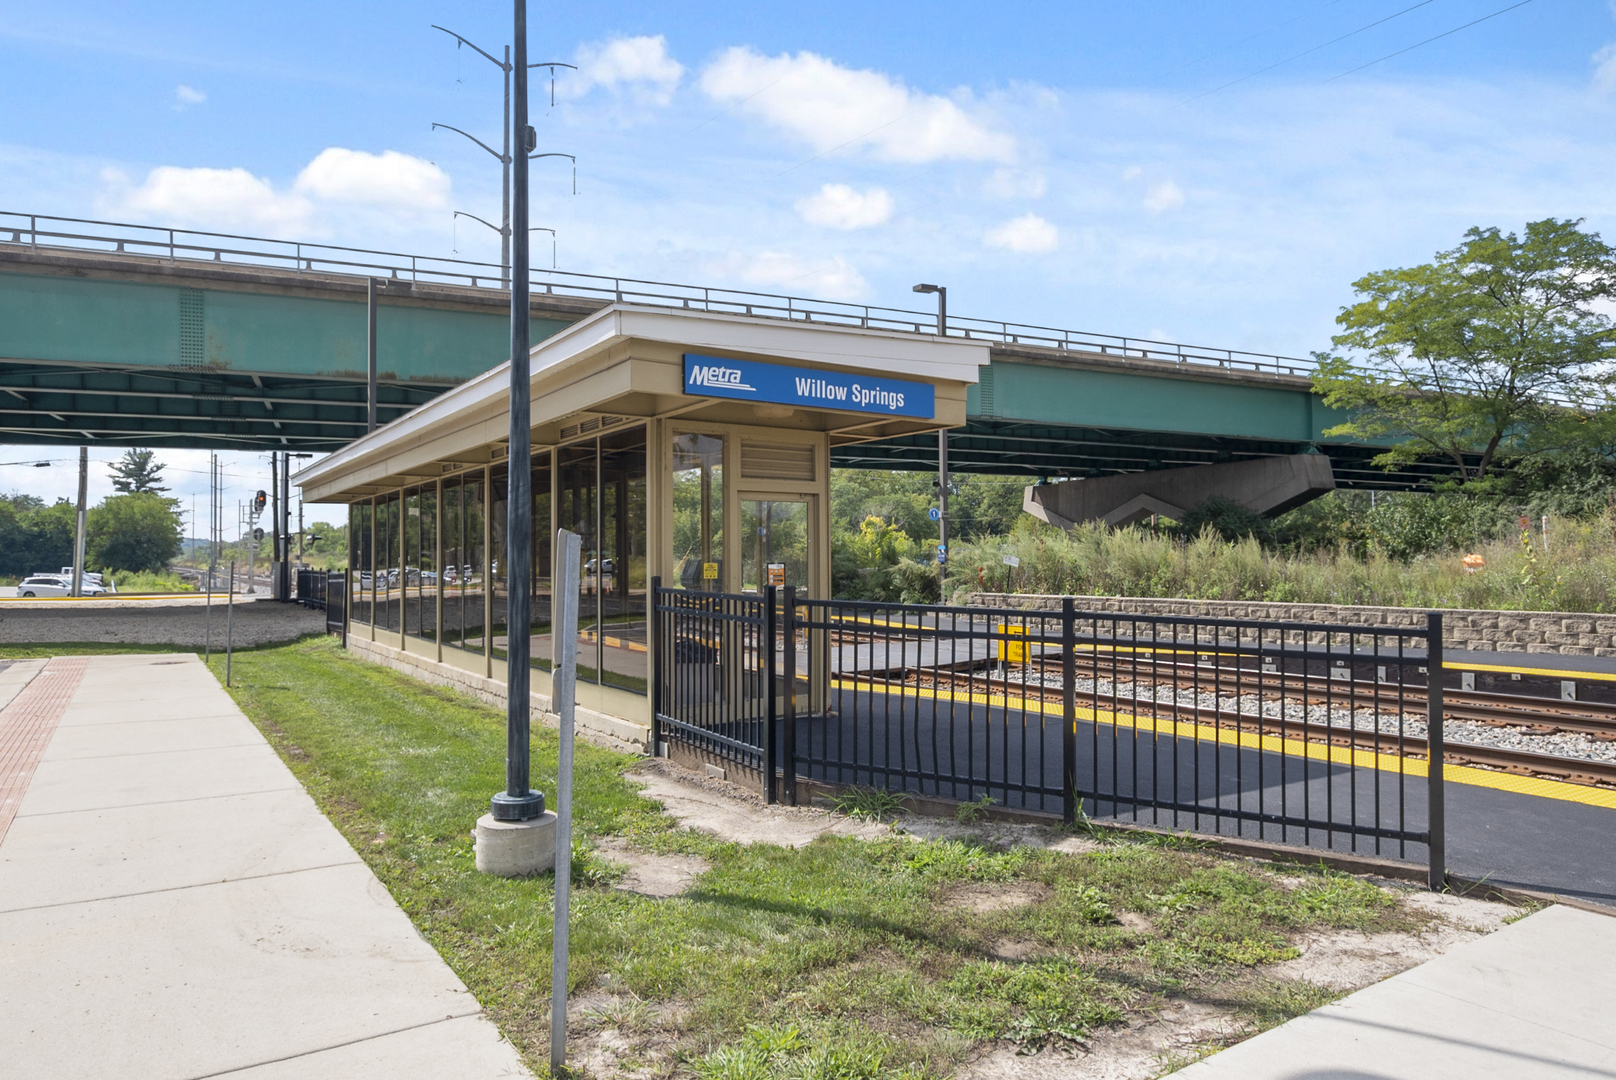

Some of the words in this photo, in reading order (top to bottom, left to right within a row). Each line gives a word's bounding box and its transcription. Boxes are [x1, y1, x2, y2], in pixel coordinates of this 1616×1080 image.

[689, 365, 742, 386] Metra
[795, 377, 848, 401] Willow
[852, 384, 905, 410] Springs
